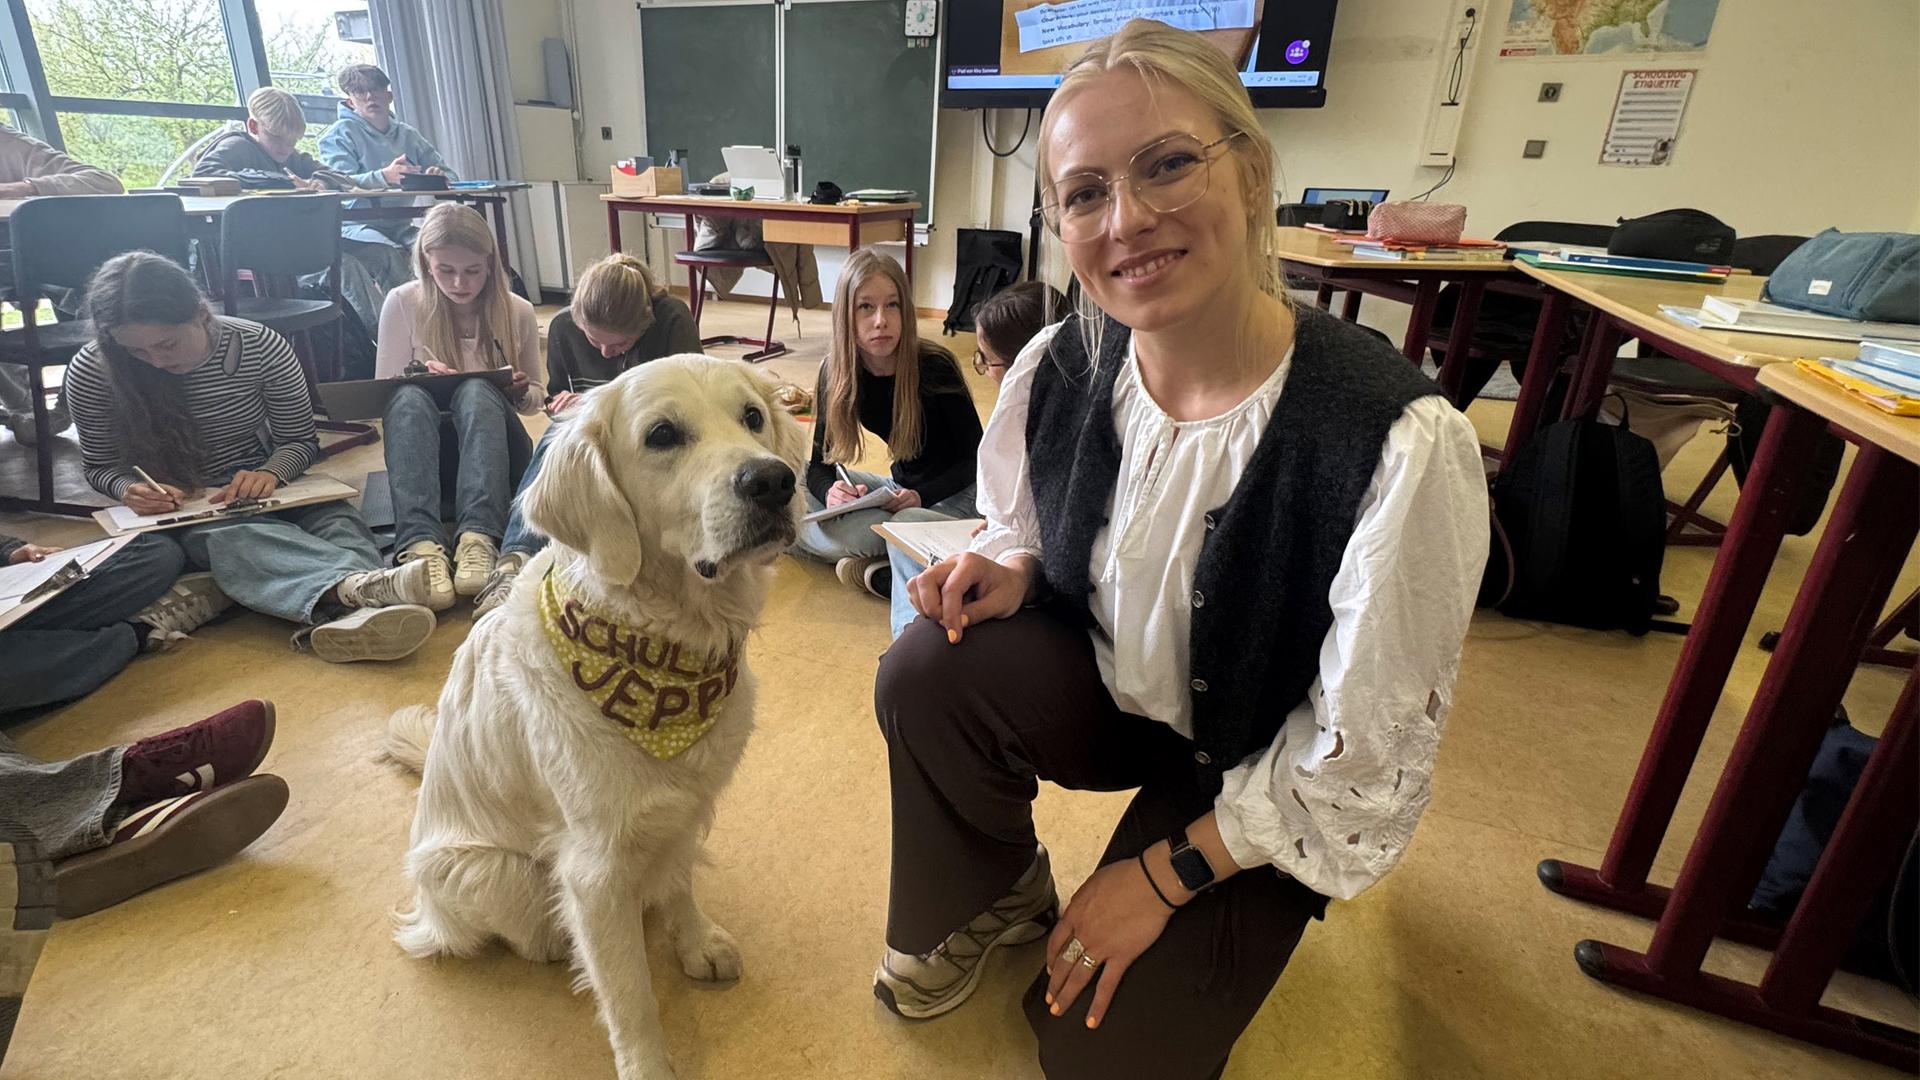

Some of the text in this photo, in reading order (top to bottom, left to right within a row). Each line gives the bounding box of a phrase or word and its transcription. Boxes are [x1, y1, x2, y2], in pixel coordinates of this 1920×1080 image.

[1632, 71, 1687, 79] SCHOOLDOG
[1633, 80, 1681, 88] ETIQUETTE
[558, 598, 722, 678] SCHUL
